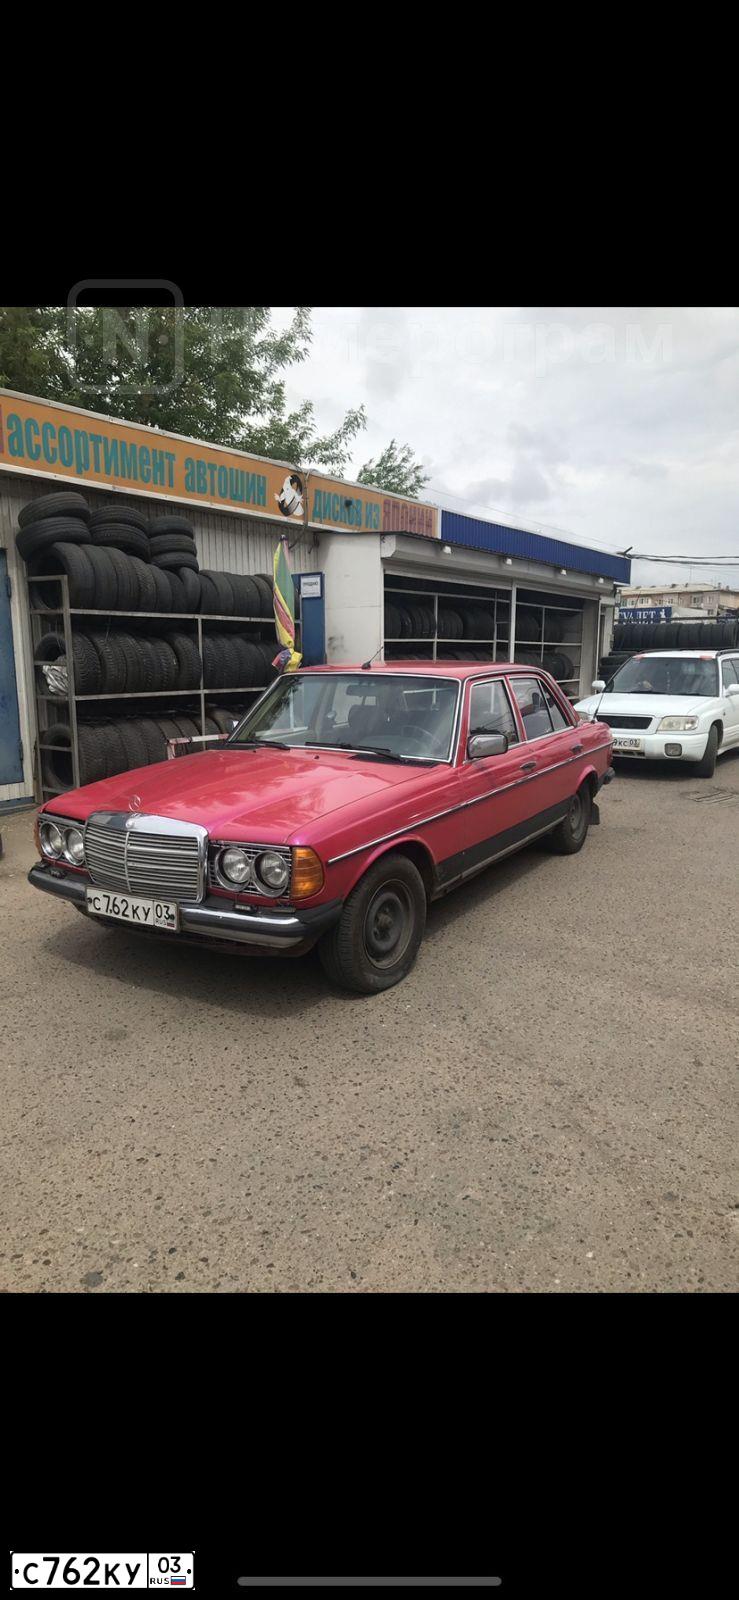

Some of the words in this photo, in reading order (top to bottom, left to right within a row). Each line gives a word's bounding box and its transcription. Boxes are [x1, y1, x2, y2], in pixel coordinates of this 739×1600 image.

[7, 412, 176, 488] ассортимент
[185, 457, 267, 507] автошин
[366, 502, 380, 530] из
[93, 894, 151, 922] С762КУ
[155, 903, 171, 920] 03
